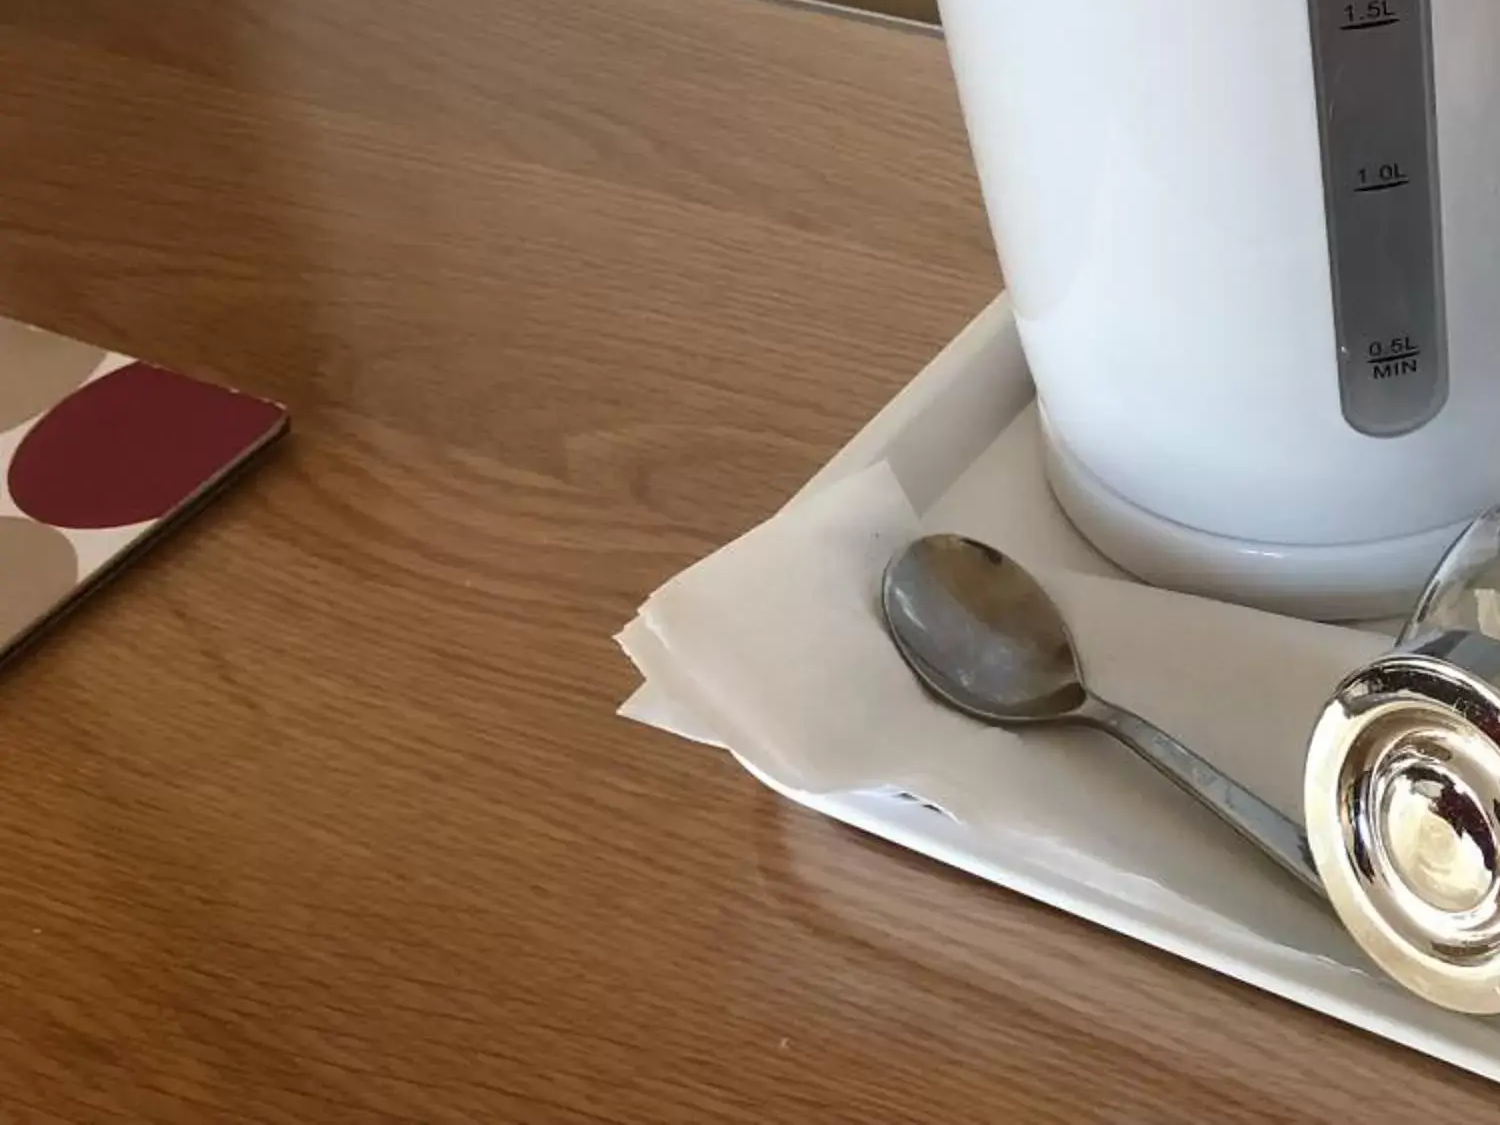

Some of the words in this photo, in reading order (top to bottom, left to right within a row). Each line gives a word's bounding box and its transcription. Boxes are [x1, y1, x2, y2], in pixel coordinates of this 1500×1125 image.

[1344, 0, 1396, 22] 1.5L
[1369, 337, 1418, 356] 0.5L
[1373, 358, 1418, 380] MIN
